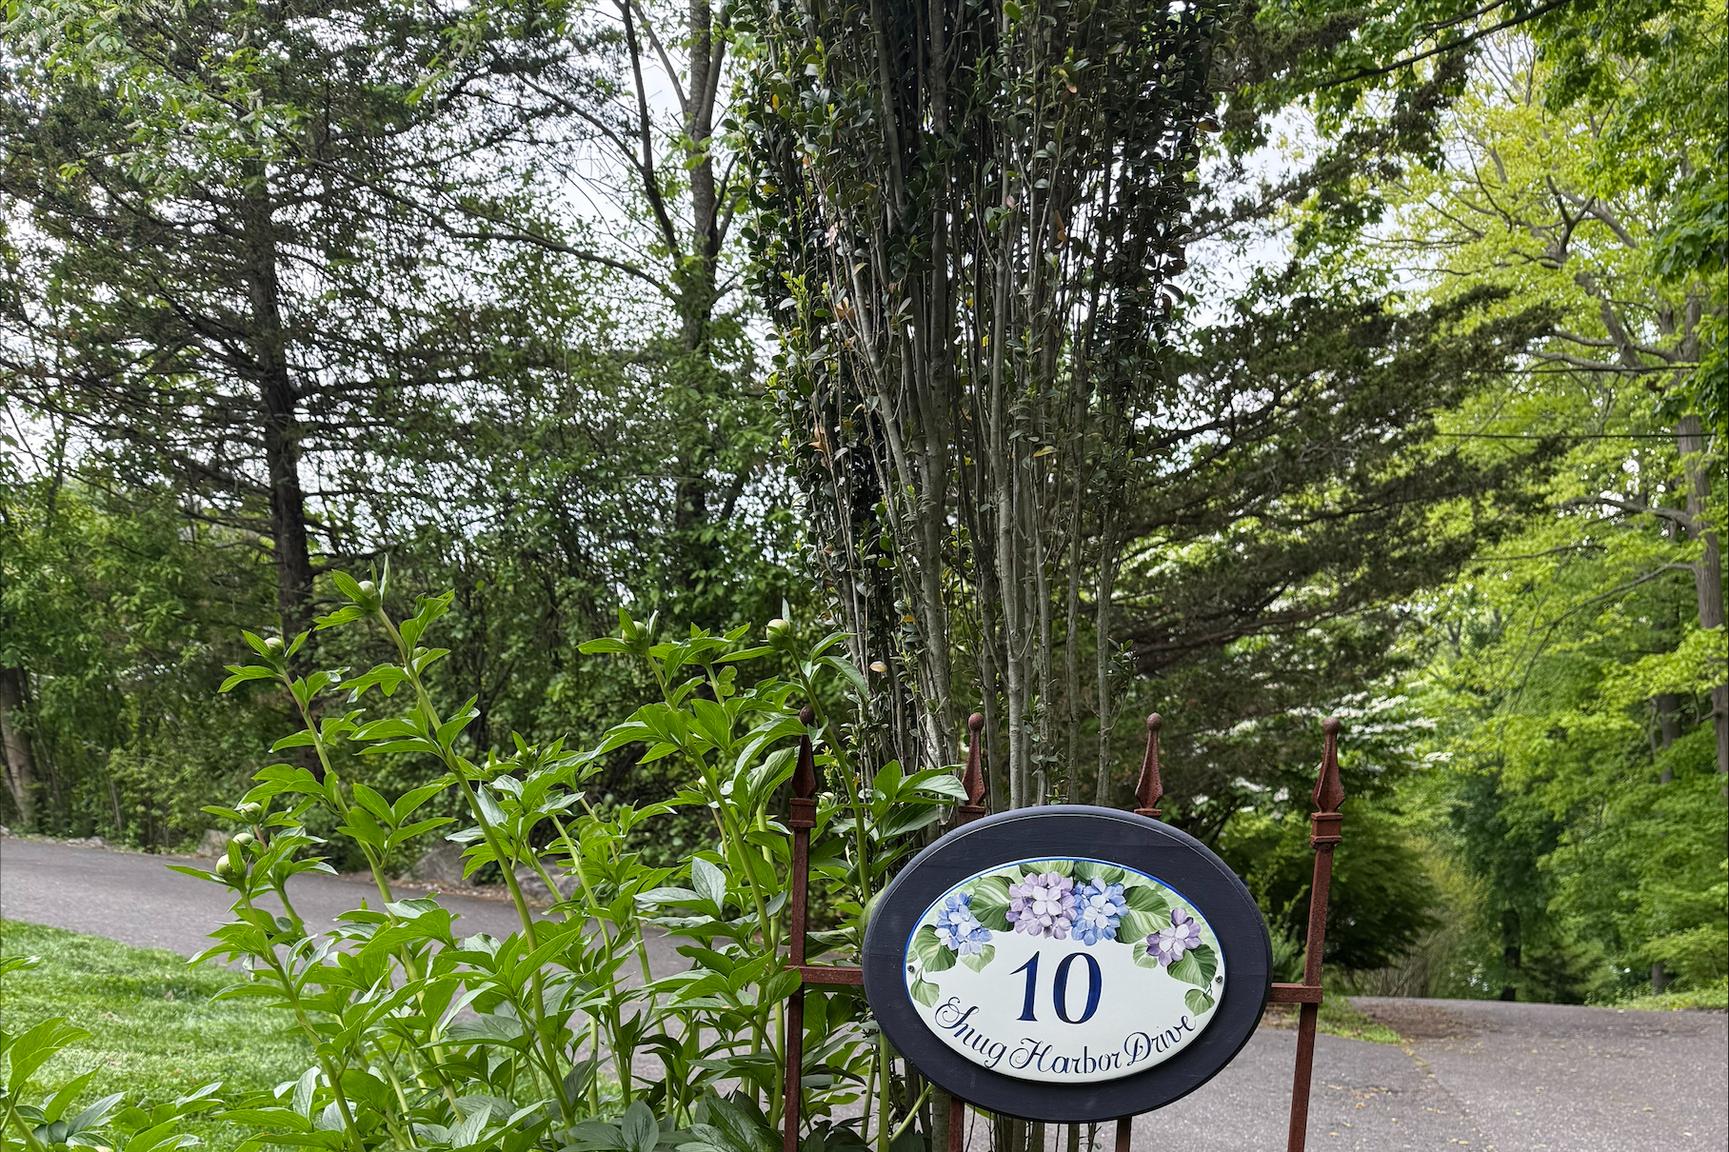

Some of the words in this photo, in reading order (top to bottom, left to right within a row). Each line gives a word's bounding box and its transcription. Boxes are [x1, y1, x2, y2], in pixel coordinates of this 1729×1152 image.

[1008, 950, 1103, 1025] 10
[934, 996, 1008, 1070] Snug
[1008, 1037, 1120, 1075] Harbor
[1123, 1013, 1196, 1066] Drive
